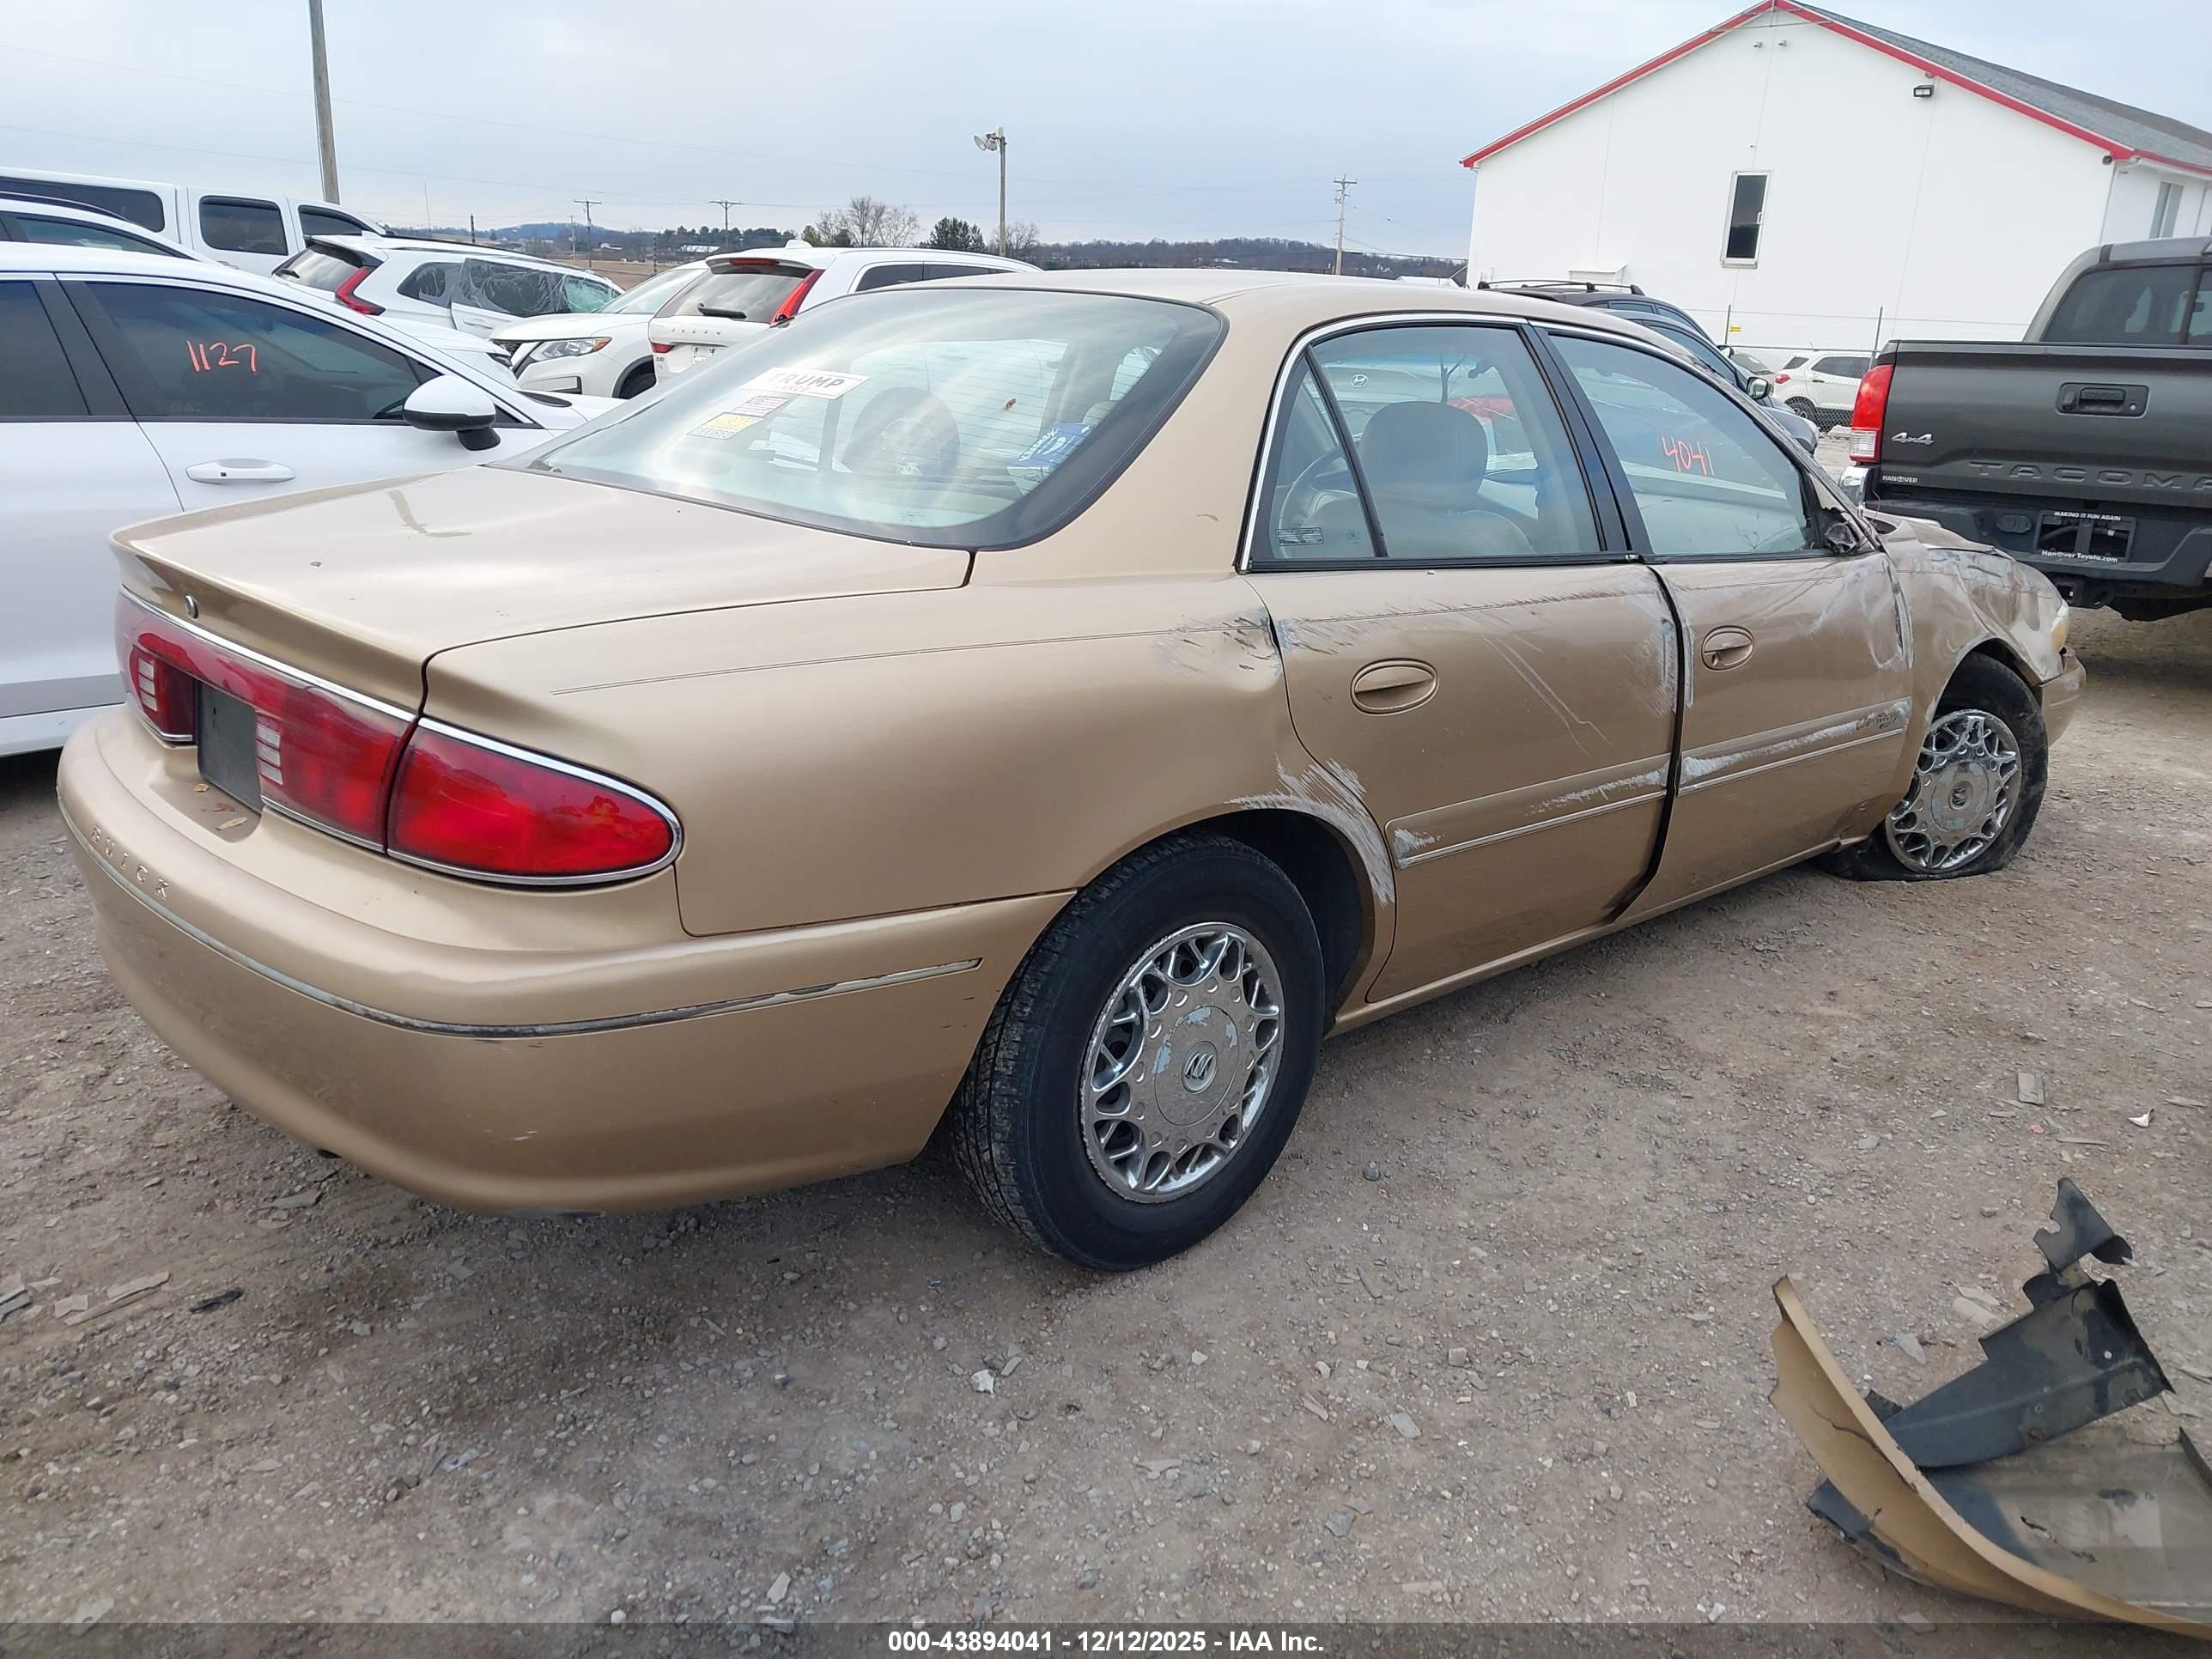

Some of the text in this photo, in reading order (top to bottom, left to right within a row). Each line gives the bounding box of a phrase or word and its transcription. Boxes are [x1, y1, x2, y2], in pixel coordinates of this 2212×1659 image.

[185, 339, 257, 373] 1127
[770, 373, 845, 388] TRUMP
[1890, 431, 1936, 446] 4x4
[1661, 435, 1716, 477] 4041
[2053, 510, 2079, 519] MAKING
[2076, 552, 2118, 563] Toyota.com
[90, 823, 170, 900] BUICK
